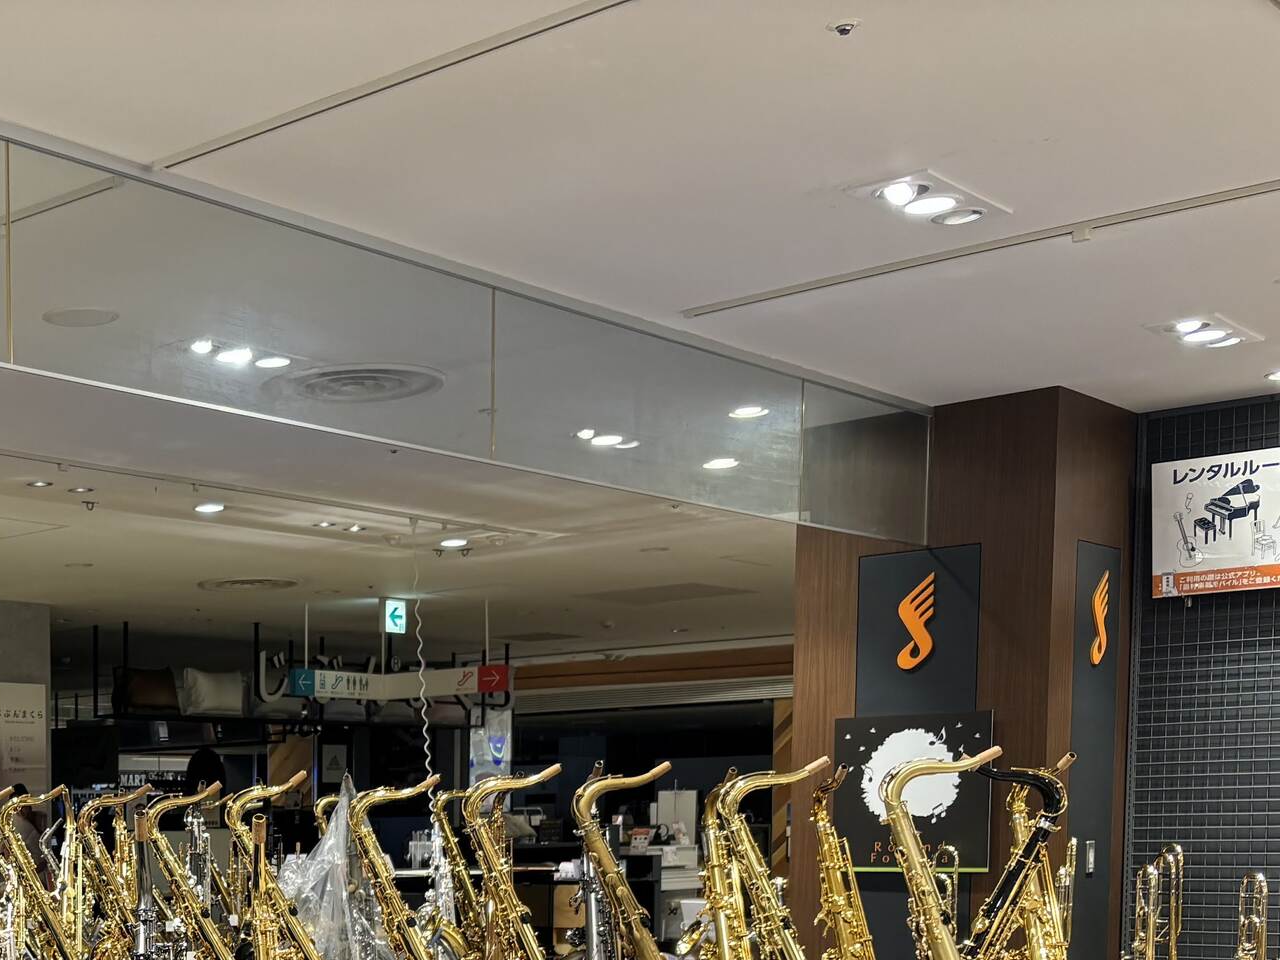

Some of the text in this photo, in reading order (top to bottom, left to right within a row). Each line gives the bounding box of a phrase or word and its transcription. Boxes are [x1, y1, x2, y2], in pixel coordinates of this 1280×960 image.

[1173, 459, 1280, 485] レンタルルー
